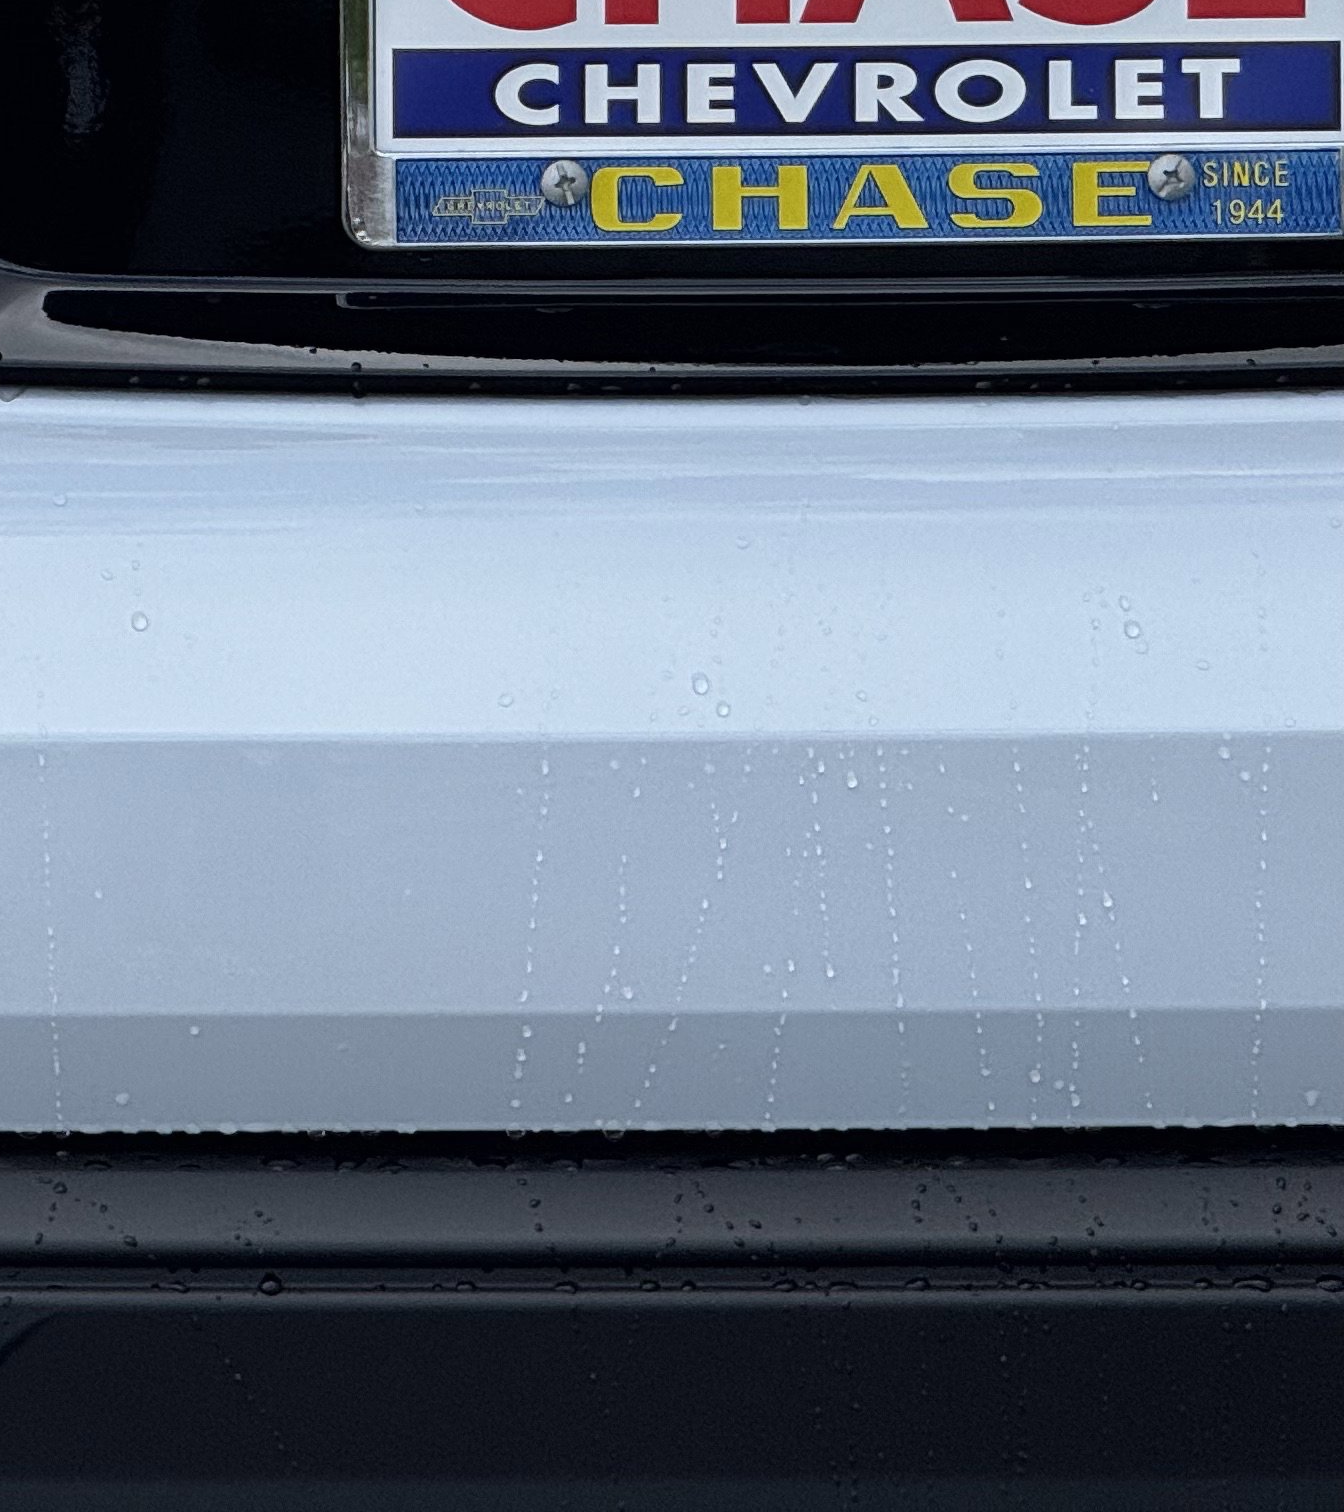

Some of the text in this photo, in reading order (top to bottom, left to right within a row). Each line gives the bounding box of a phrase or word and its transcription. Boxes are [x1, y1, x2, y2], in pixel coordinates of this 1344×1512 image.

[494, 58, 1242, 127] CHEVROLET
[590, 158, 1153, 232] CHASE
[1202, 159, 1290, 188] SINCE
[1211, 198, 1285, 226] 1944
